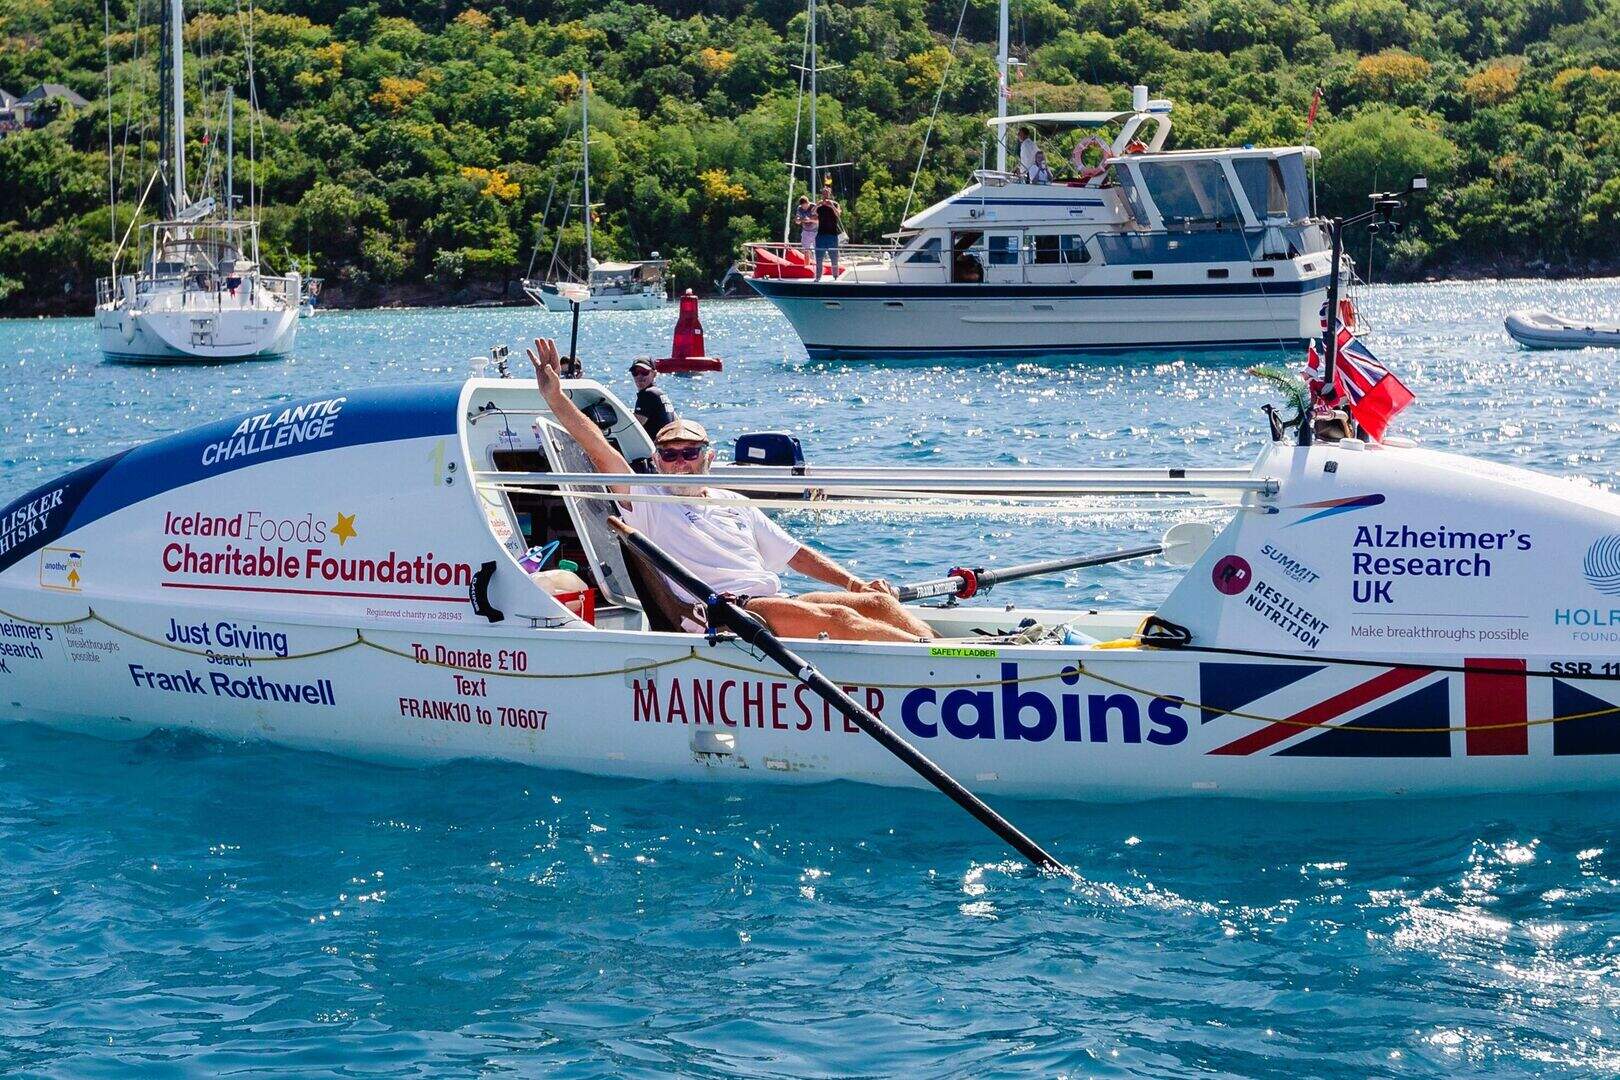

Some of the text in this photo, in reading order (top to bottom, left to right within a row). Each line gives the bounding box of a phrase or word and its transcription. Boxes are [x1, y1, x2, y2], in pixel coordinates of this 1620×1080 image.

[231, 397, 347, 438] ATLANTIC
[201, 414, 338, 466] CHALLENGE
[164, 511, 328, 543] Iceland Foods
[1353, 525, 1533, 551] Alzheimer's
[44, 562, 68, 571] another
[162, 543, 472, 586] Charitable Foundation
[1261, 544, 1321, 584] SUMMIT
[1352, 553, 1492, 577] Research
[1352, 580, 1393, 603] UK
[366, 608, 401, 618] Registered
[401, 611, 426, 621] charity
[1254, 580, 1330, 635] RESILIENT
[64, 624, 84, 636] Make
[1245, 593, 1320, 650] NUTRITION
[67, 637, 121, 654] breakthroughs
[166, 618, 288, 658] Just Giving
[1351, 626, 1530, 643] Make breakthroughs possible
[1572, 632, 1620, 642] FOUND
[71, 653, 101, 664] possible
[206, 649, 252, 668] Search
[412, 643, 528, 672] To Donate £10
[932, 648, 996, 659] SAFETY LADDER
[1550, 661, 1593, 676] SSR
[128, 663, 336, 706] Frank Rothwell
[453, 675, 487, 698] Text
[398, 697, 548, 731] FRANK10 to 70607
[901, 663, 1189, 745] cabins
